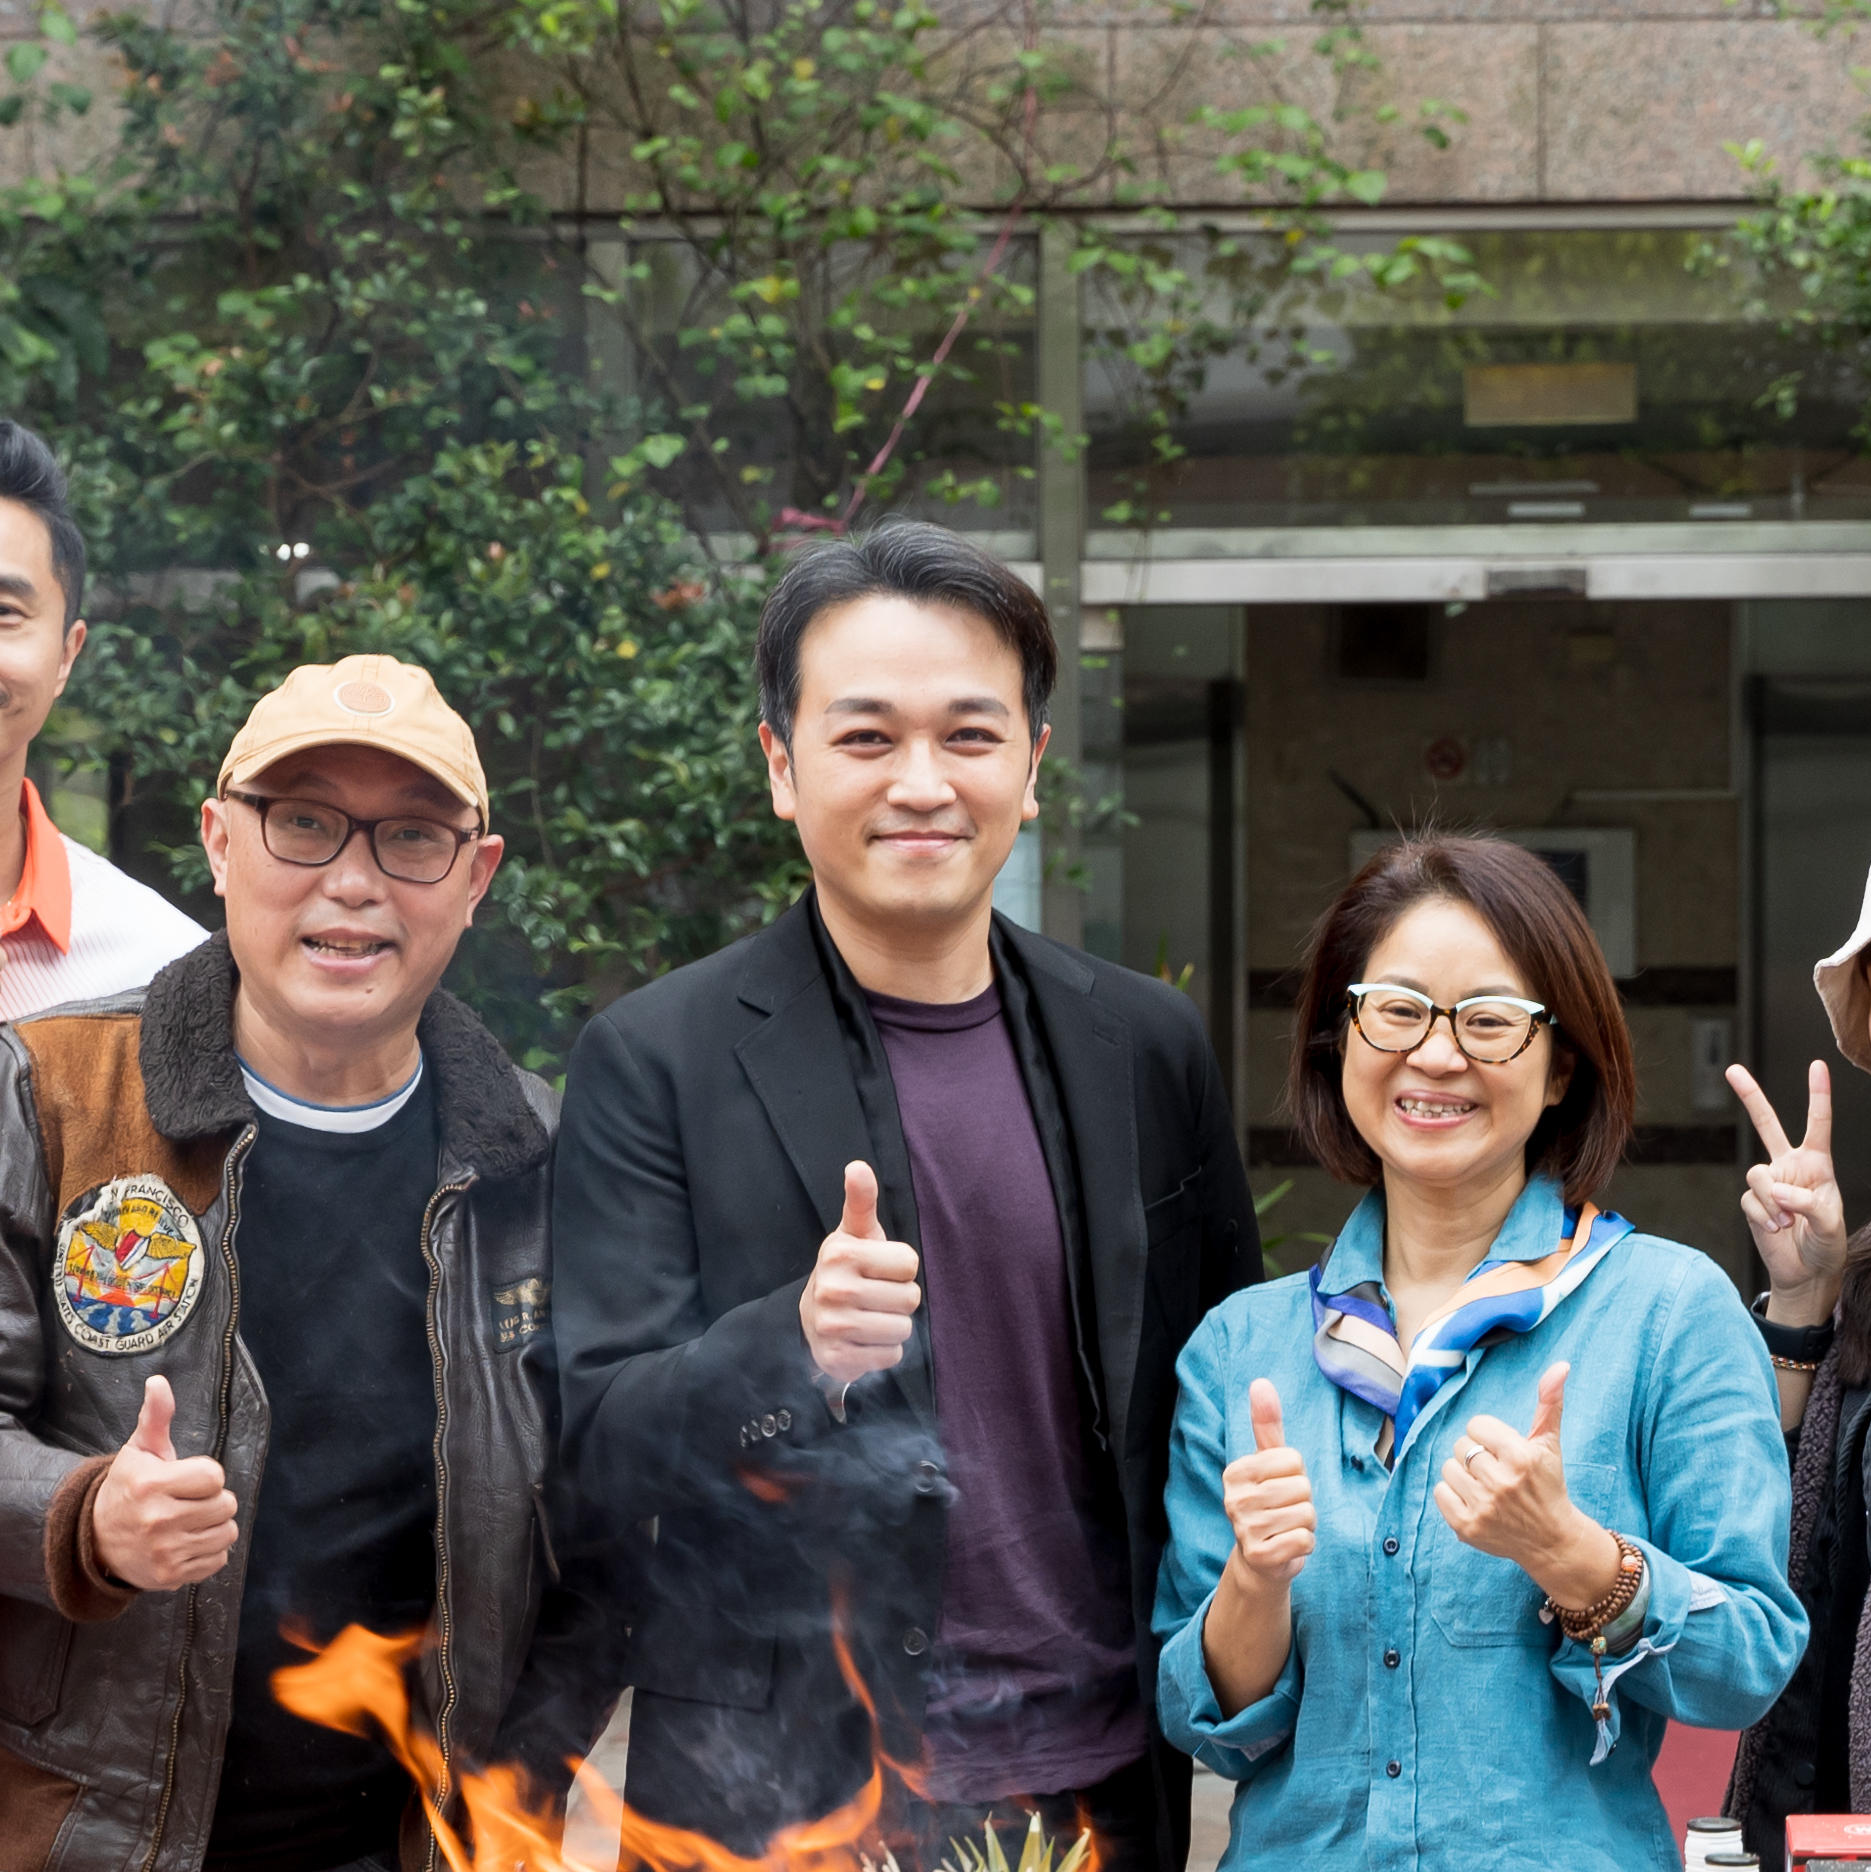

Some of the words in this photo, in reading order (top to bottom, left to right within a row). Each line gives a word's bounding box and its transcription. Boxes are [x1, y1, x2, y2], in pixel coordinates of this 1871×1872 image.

[74, 1323, 110, 1349] COAST
[115, 1333, 155, 1351] GUARD
[157, 1321, 175, 1342] AIR
